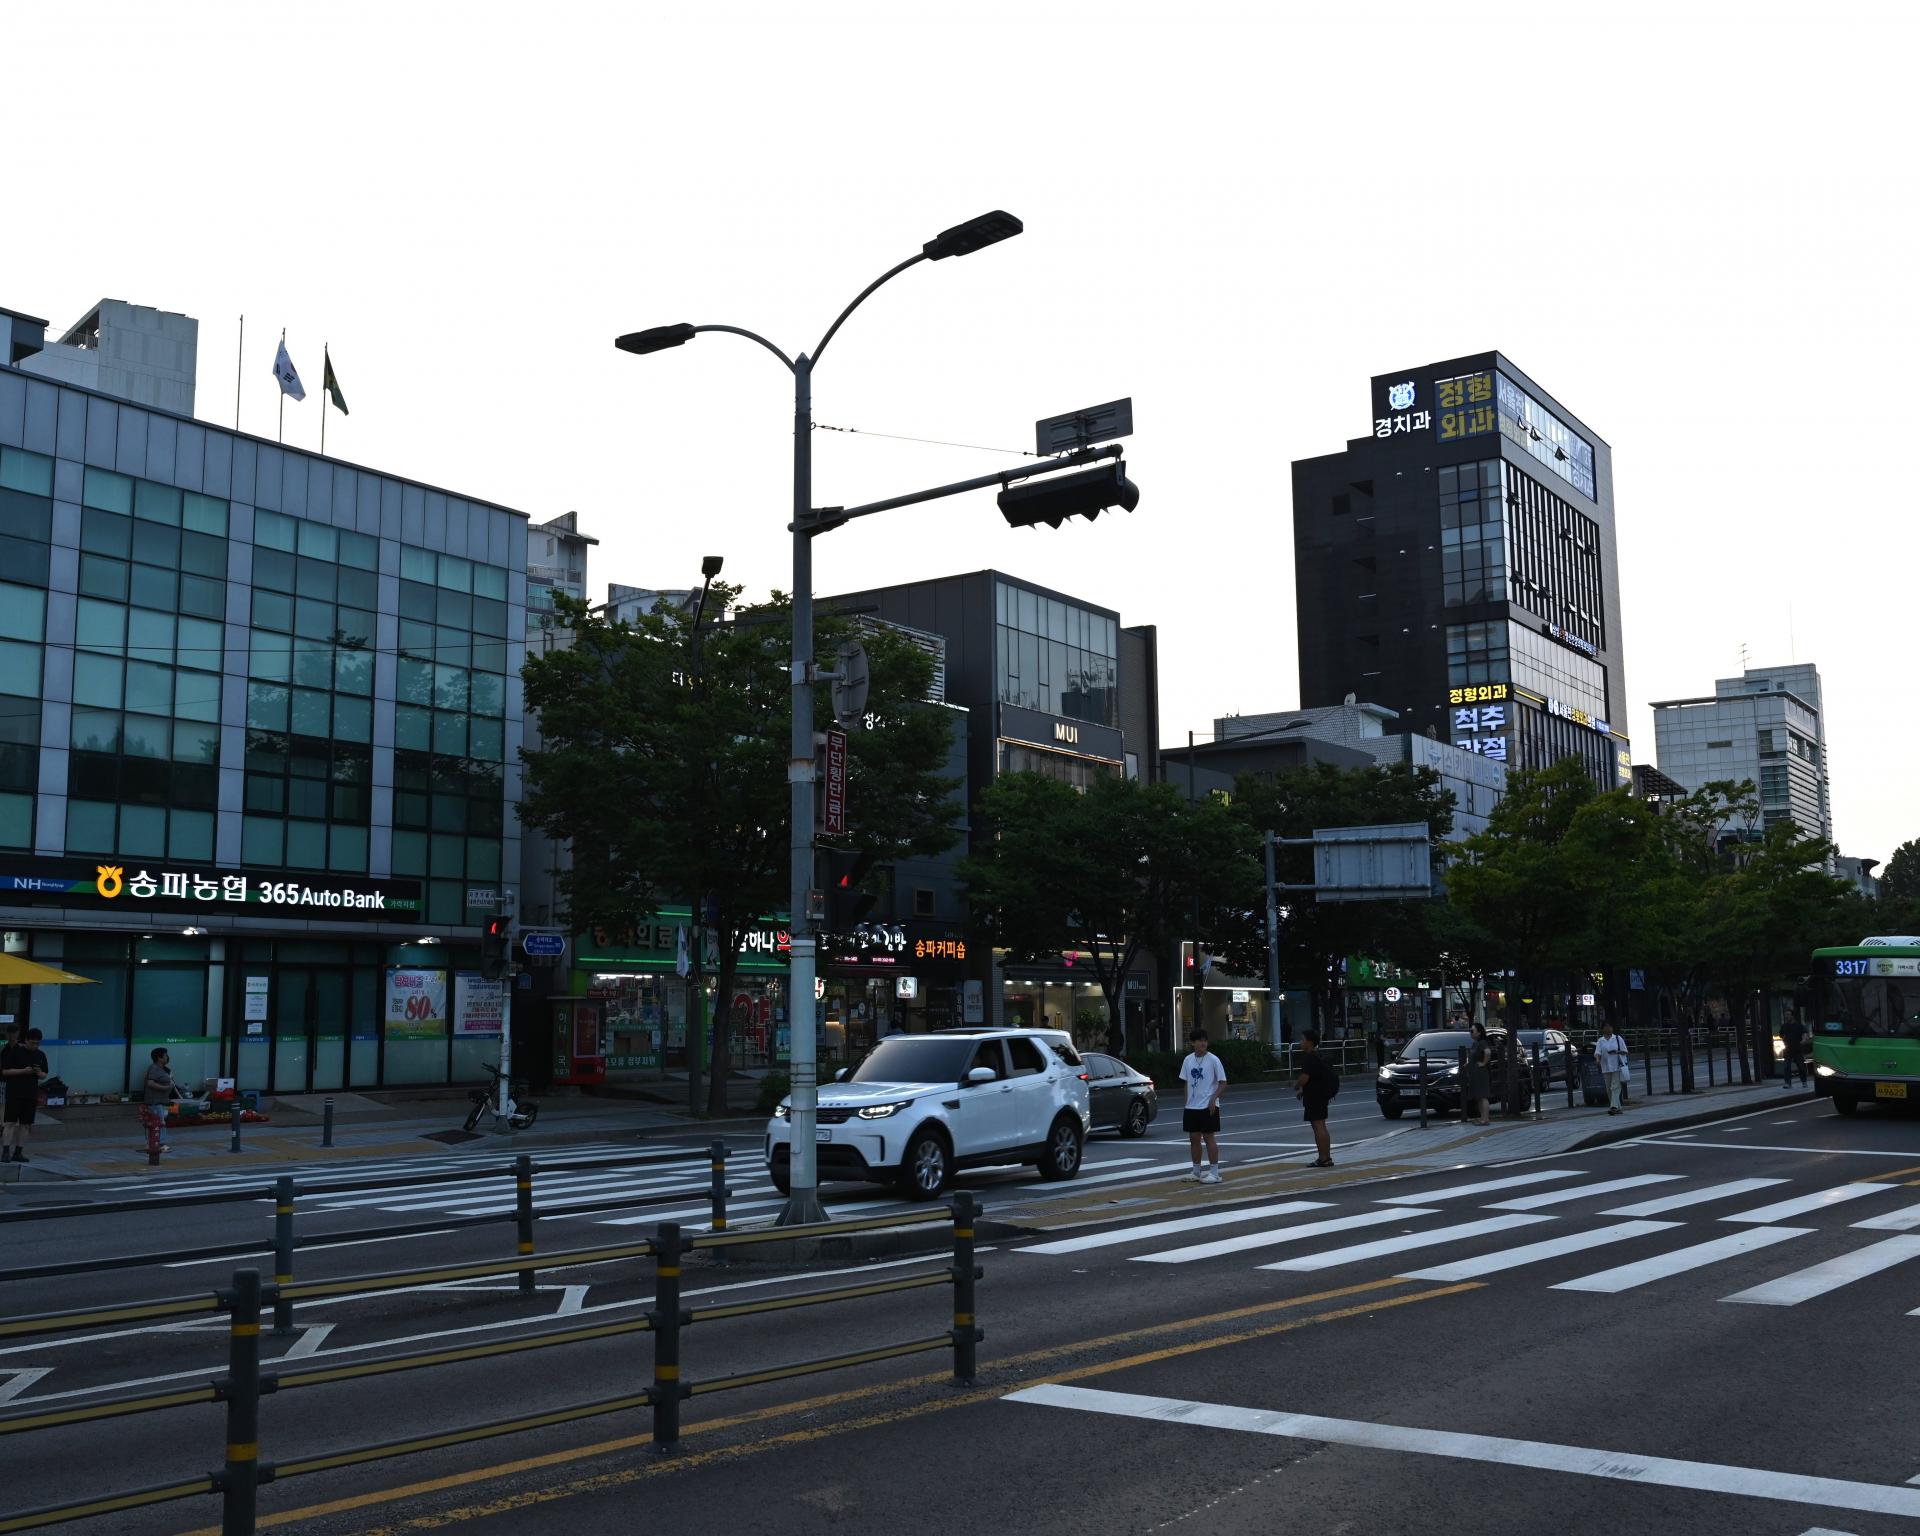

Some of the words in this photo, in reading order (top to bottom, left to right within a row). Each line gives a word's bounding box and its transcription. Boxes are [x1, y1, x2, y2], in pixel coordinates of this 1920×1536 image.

[1439, 374, 1493, 408] 정형
[1375, 410, 1431, 438] 경치과
[1440, 405, 1495, 439] 외과
[1449, 684, 1507, 704] 정형외과
[1455, 705, 1505, 732] 척추
[1055, 723, 1078, 743] MUI
[829, 735, 843, 831] 무단횡단금지
[14, 877, 41, 890] NH
[129, 870, 247, 902] 송파농협
[343, 889, 385, 909] Bank
[915, 939, 967, 959] 송파커피숍
[1836, 961, 1867, 975] 3317
[1387, 989, 1397, 1000] 약
